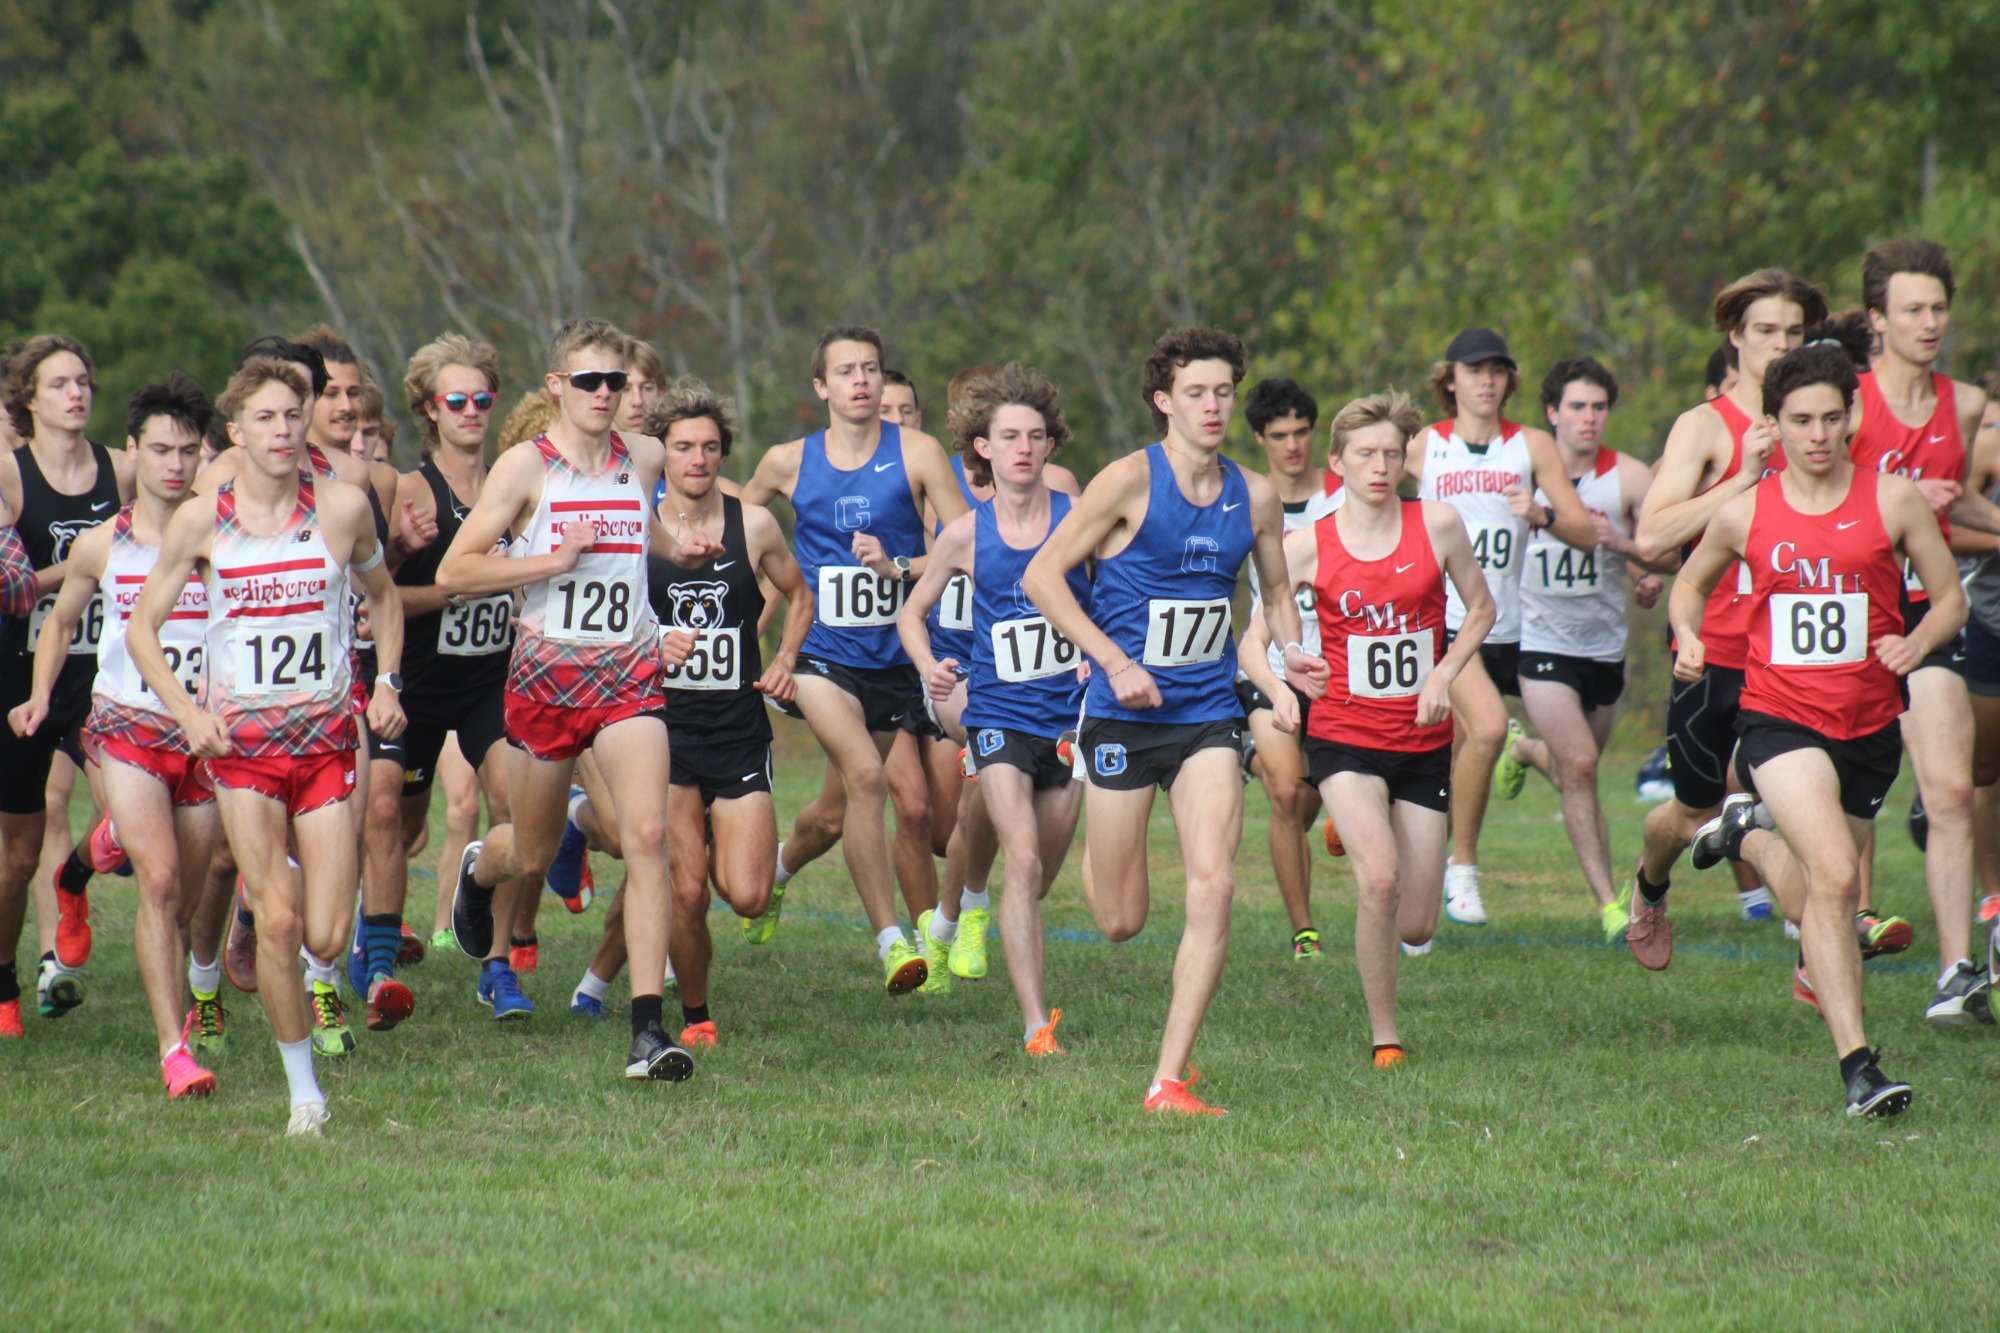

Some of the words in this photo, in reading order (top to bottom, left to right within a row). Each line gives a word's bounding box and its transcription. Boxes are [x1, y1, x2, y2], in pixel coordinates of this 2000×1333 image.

[835, 495, 870, 533] G
[1180, 535, 1219, 575] G
[1535, 547, 1598, 588] 144
[229, 576, 320, 604] edinboro
[558, 580, 630, 633] 128
[828, 572, 898, 618] 169
[445, 601, 509, 648] 369
[1001, 622, 1075, 672] 178
[1159, 604, 1227, 657] 177
[1791, 600, 1847, 655] 68
[245, 632, 326, 685] 124
[1367, 638, 1419, 690] 66
[1094, 743, 1128, 777] G
